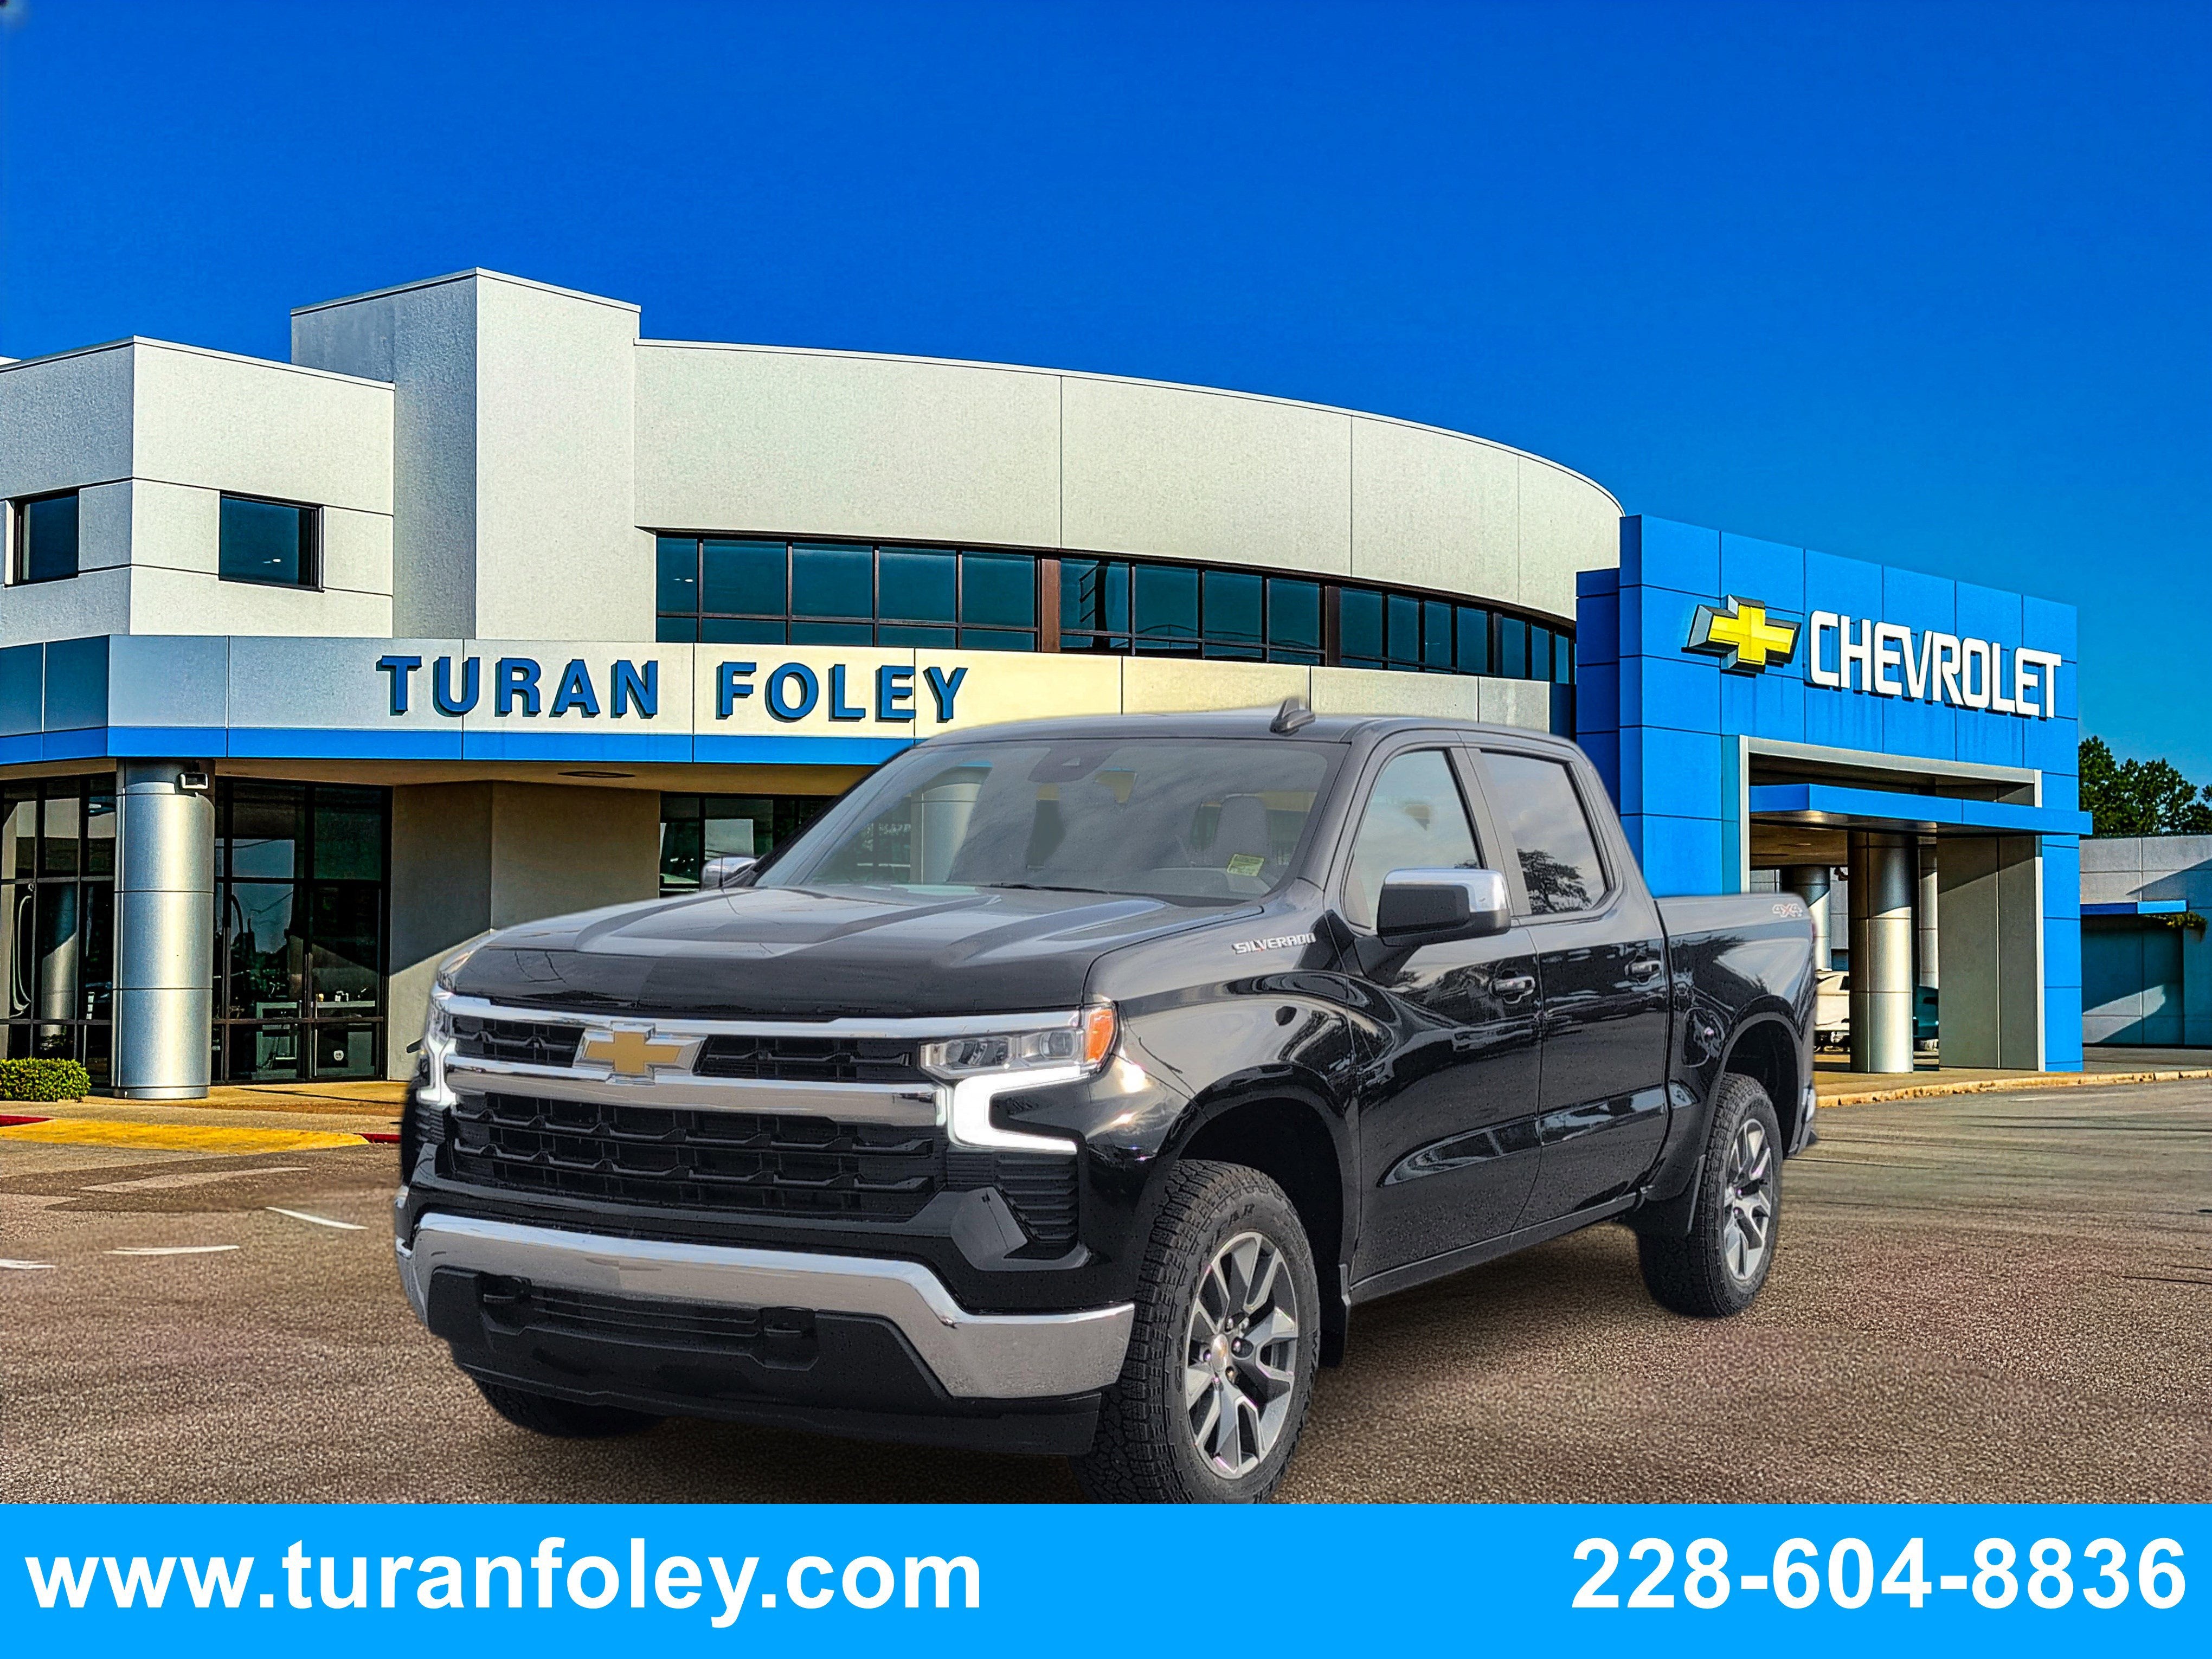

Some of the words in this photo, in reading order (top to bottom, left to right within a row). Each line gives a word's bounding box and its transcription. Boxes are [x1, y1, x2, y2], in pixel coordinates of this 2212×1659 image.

[376, 655, 658, 719] TURAN
[716, 661, 968, 723] FOLEY
[1809, 609, 2062, 719] CHEVROLET
[1232, 932, 1316, 954] SILVERADO
